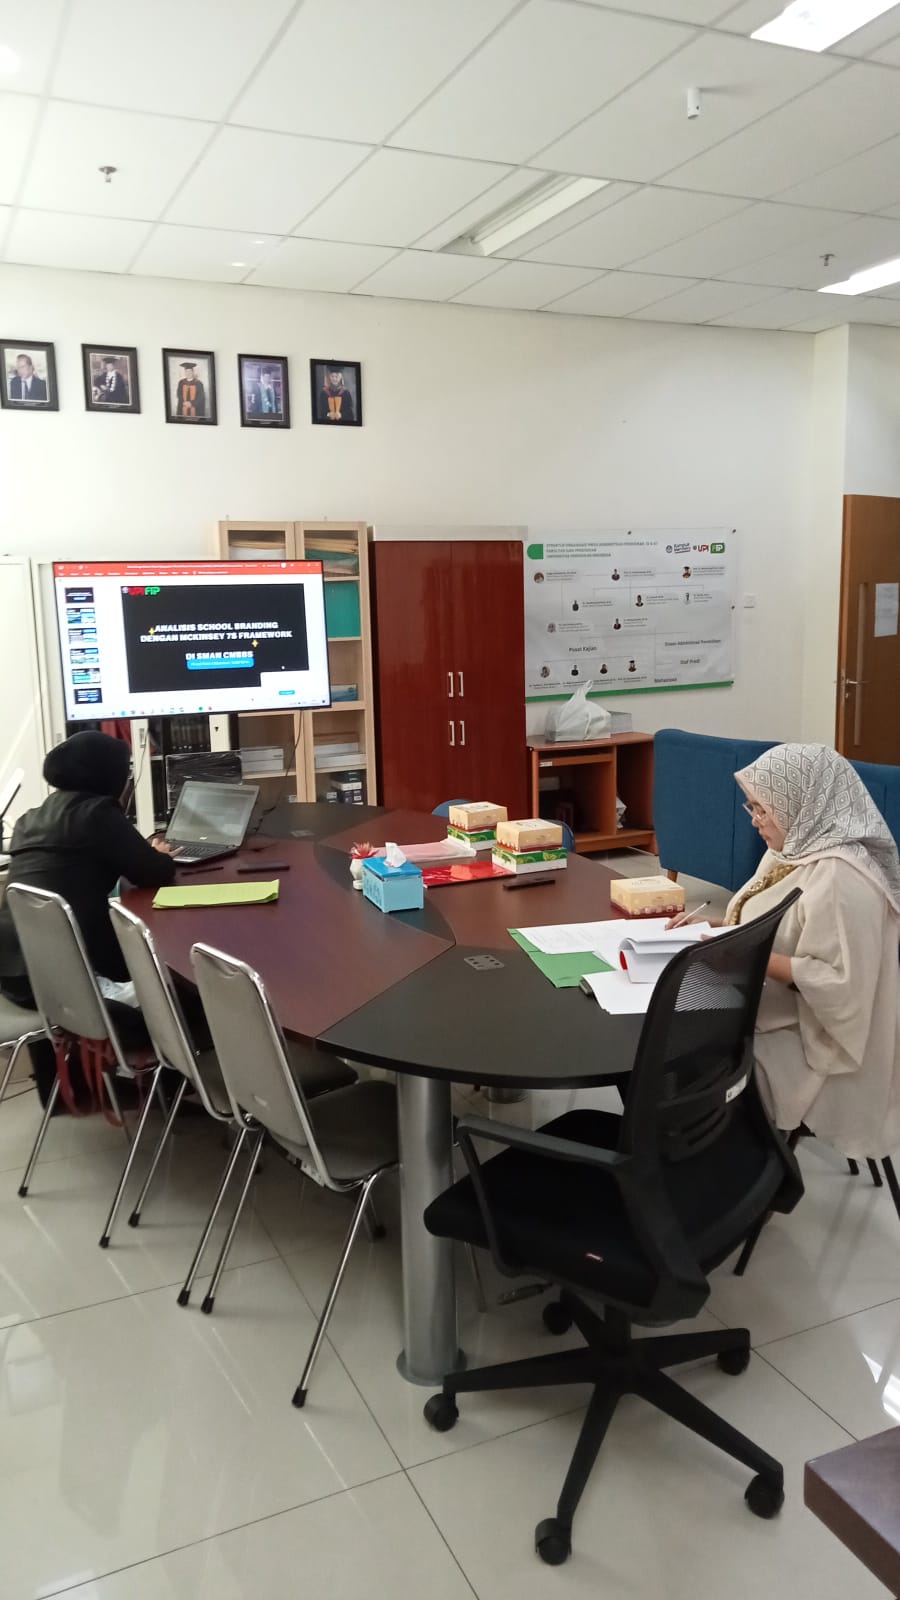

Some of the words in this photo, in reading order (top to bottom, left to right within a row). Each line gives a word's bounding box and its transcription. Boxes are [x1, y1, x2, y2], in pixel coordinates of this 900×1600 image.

[154, 624, 196, 632] ANALISIS
[234, 622, 278, 630] BRANDING
[140, 634, 178, 643] DENGAN
[180, 634, 224, 642] MCKINSEY
[238, 630, 292, 640] FRAMEWORK
